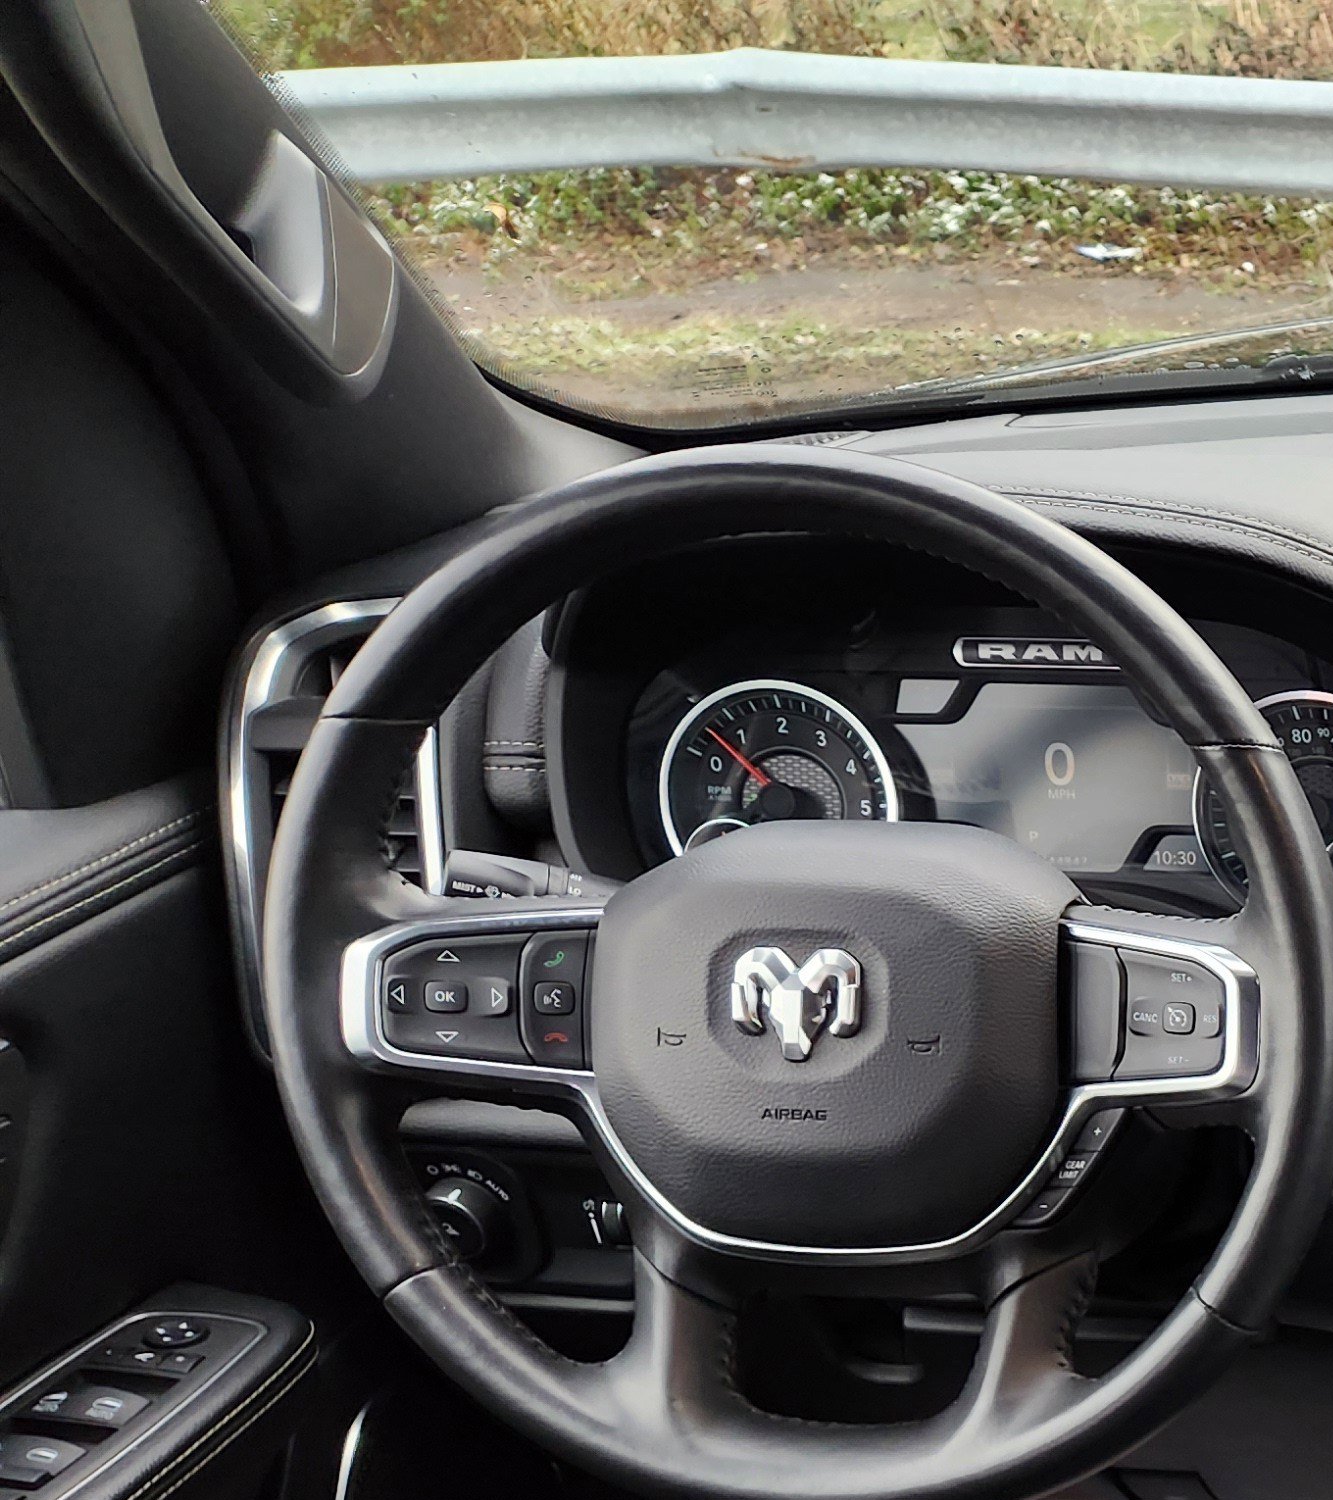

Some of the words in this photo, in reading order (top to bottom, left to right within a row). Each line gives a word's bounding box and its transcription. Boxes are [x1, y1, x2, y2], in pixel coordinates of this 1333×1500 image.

[978, 643, 1103, 661] RAM
[777, 717, 789, 734] 2
[1317, 728, 1330, 738] 90
[736, 729, 746, 744] 1
[815, 730, 827, 747] 3
[1291, 728, 1312, 744] 80
[710, 756, 723, 772] 0
[846, 759, 857, 775] 4
[1045, 742, 1075, 786] 0
[707, 785, 732, 795] RPM
[1048, 789, 1076, 800] MPH
[860, 800, 872, 816] 5
[1029, 830, 1038, 842] P
[1154, 850, 1196, 866] 10:30
[434, 991, 456, 1003] OK
[1132, 1011, 1159, 1023] CANC
[1203, 1014, 1217, 1023] RES
[760, 1108, 828, 1121] AIRBAG
[1065, 1160, 1087, 1170] GEAR
[1059, 1170, 1080, 1179] LIMIT
[485, 1179, 509, 1201] AUTO
